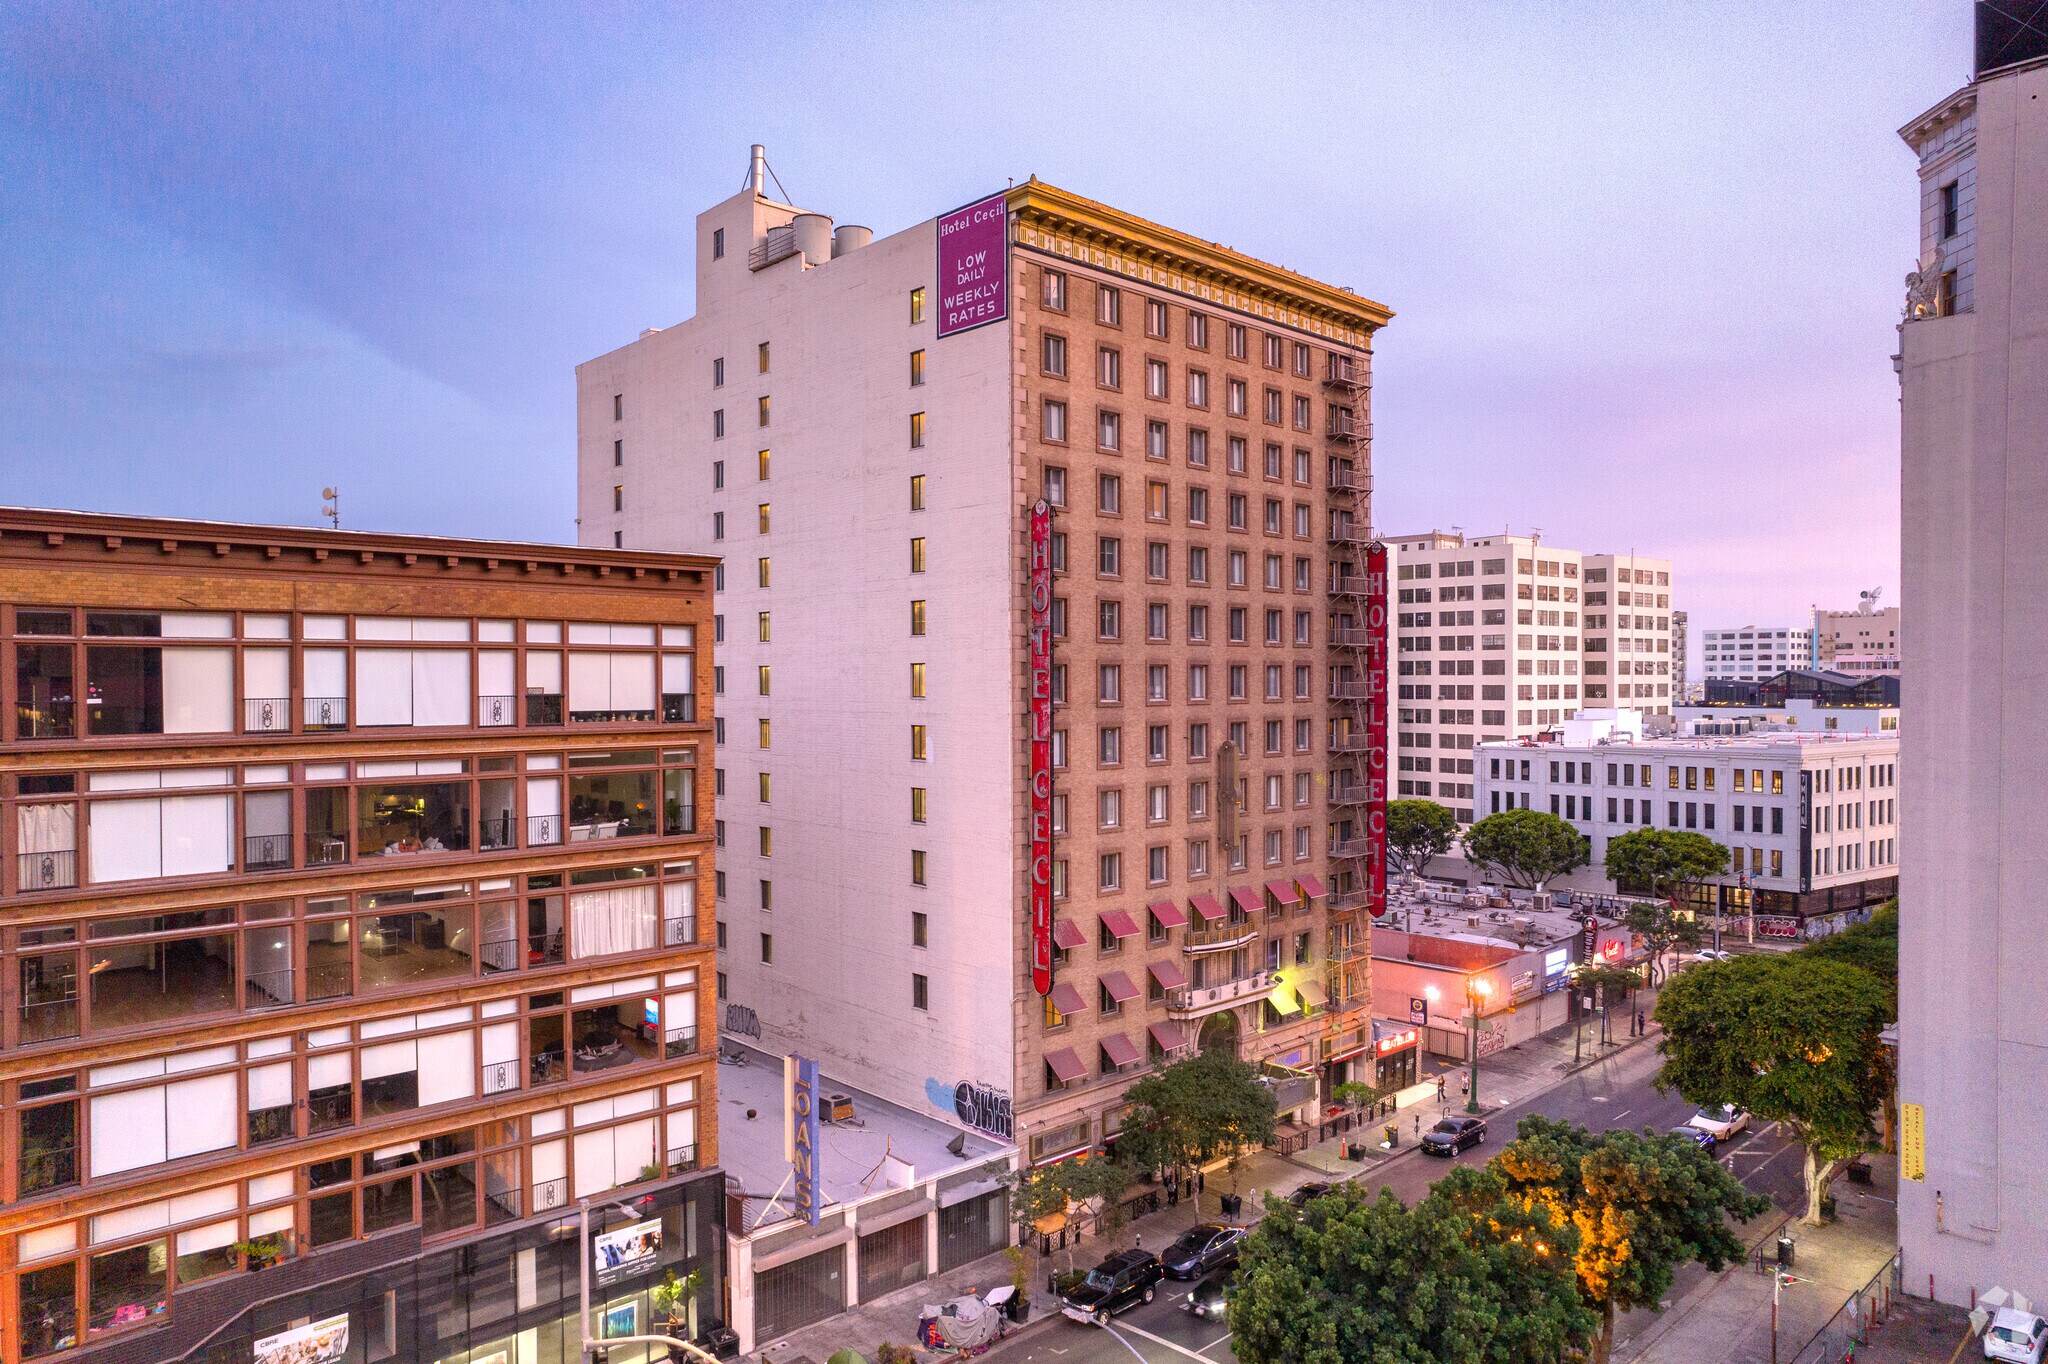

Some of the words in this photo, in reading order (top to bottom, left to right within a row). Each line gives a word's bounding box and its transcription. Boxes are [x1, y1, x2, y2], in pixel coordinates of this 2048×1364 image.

[941, 216, 970, 237] Hotel
[974, 202, 1004, 223] Cecil
[957, 250, 986, 271] LOW
[957, 266, 986, 285] DAILY
[944, 281, 1000, 309] WEEKLY
[949, 300, 995, 325] RATES
[1032, 539, 1049, 741] HOTEL
[1369, 572, 1384, 726] HOTEL
[1369, 746, 1385, 898] CECIL
[1032, 768, 1049, 971] CECIL
[794, 1059, 811, 1208] LOANS
[260, 1338, 279, 1348] CBRE
